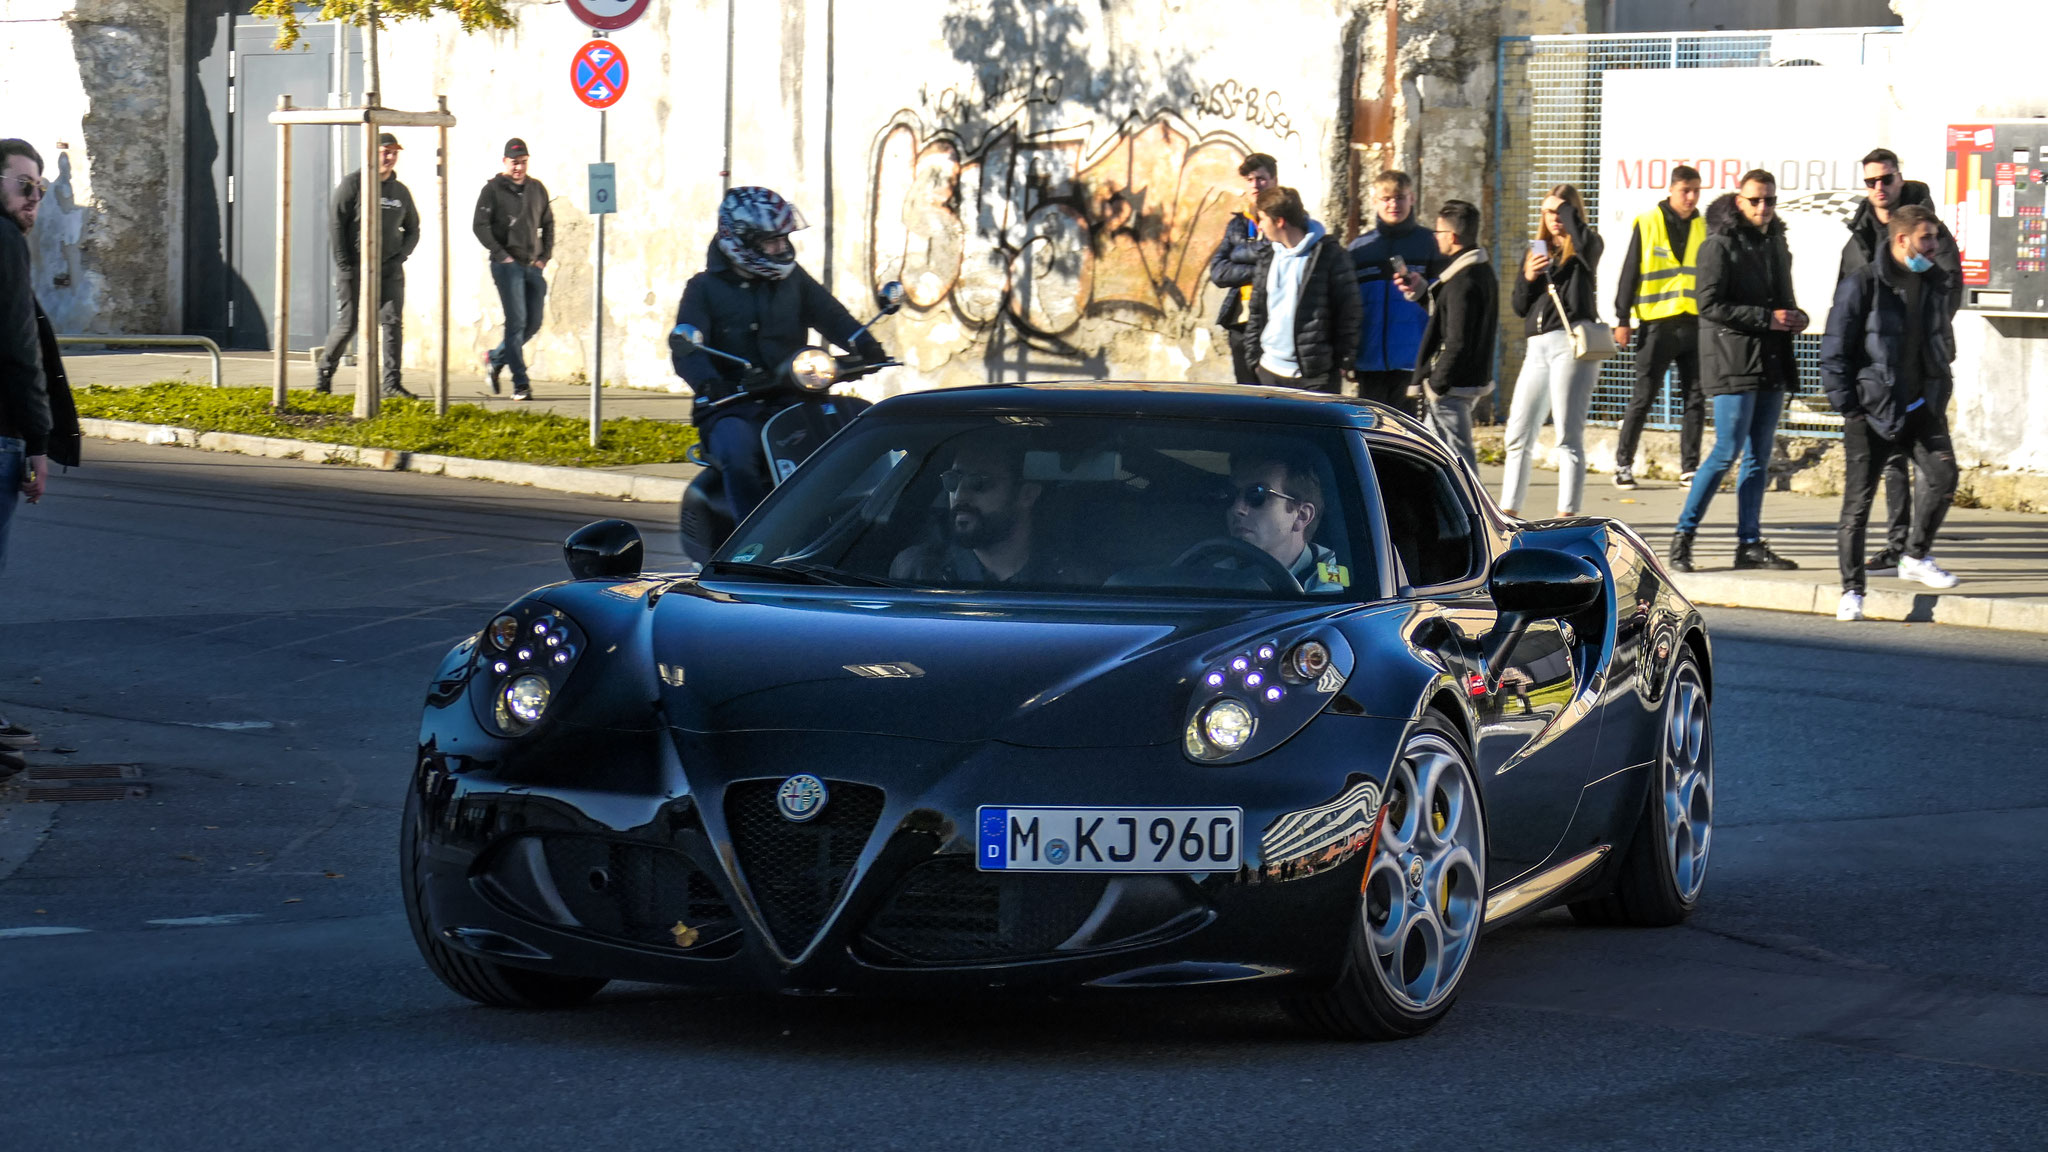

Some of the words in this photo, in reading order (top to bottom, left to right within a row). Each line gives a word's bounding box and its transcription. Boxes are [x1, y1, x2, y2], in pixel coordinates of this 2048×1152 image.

[1615, 159, 1867, 191] MOORORLD
[988, 845, 999, 858] D
[1010, 816, 1039, 861] M
[1075, 817, 1136, 862] KJ
[1150, 817, 1234, 862] 960
